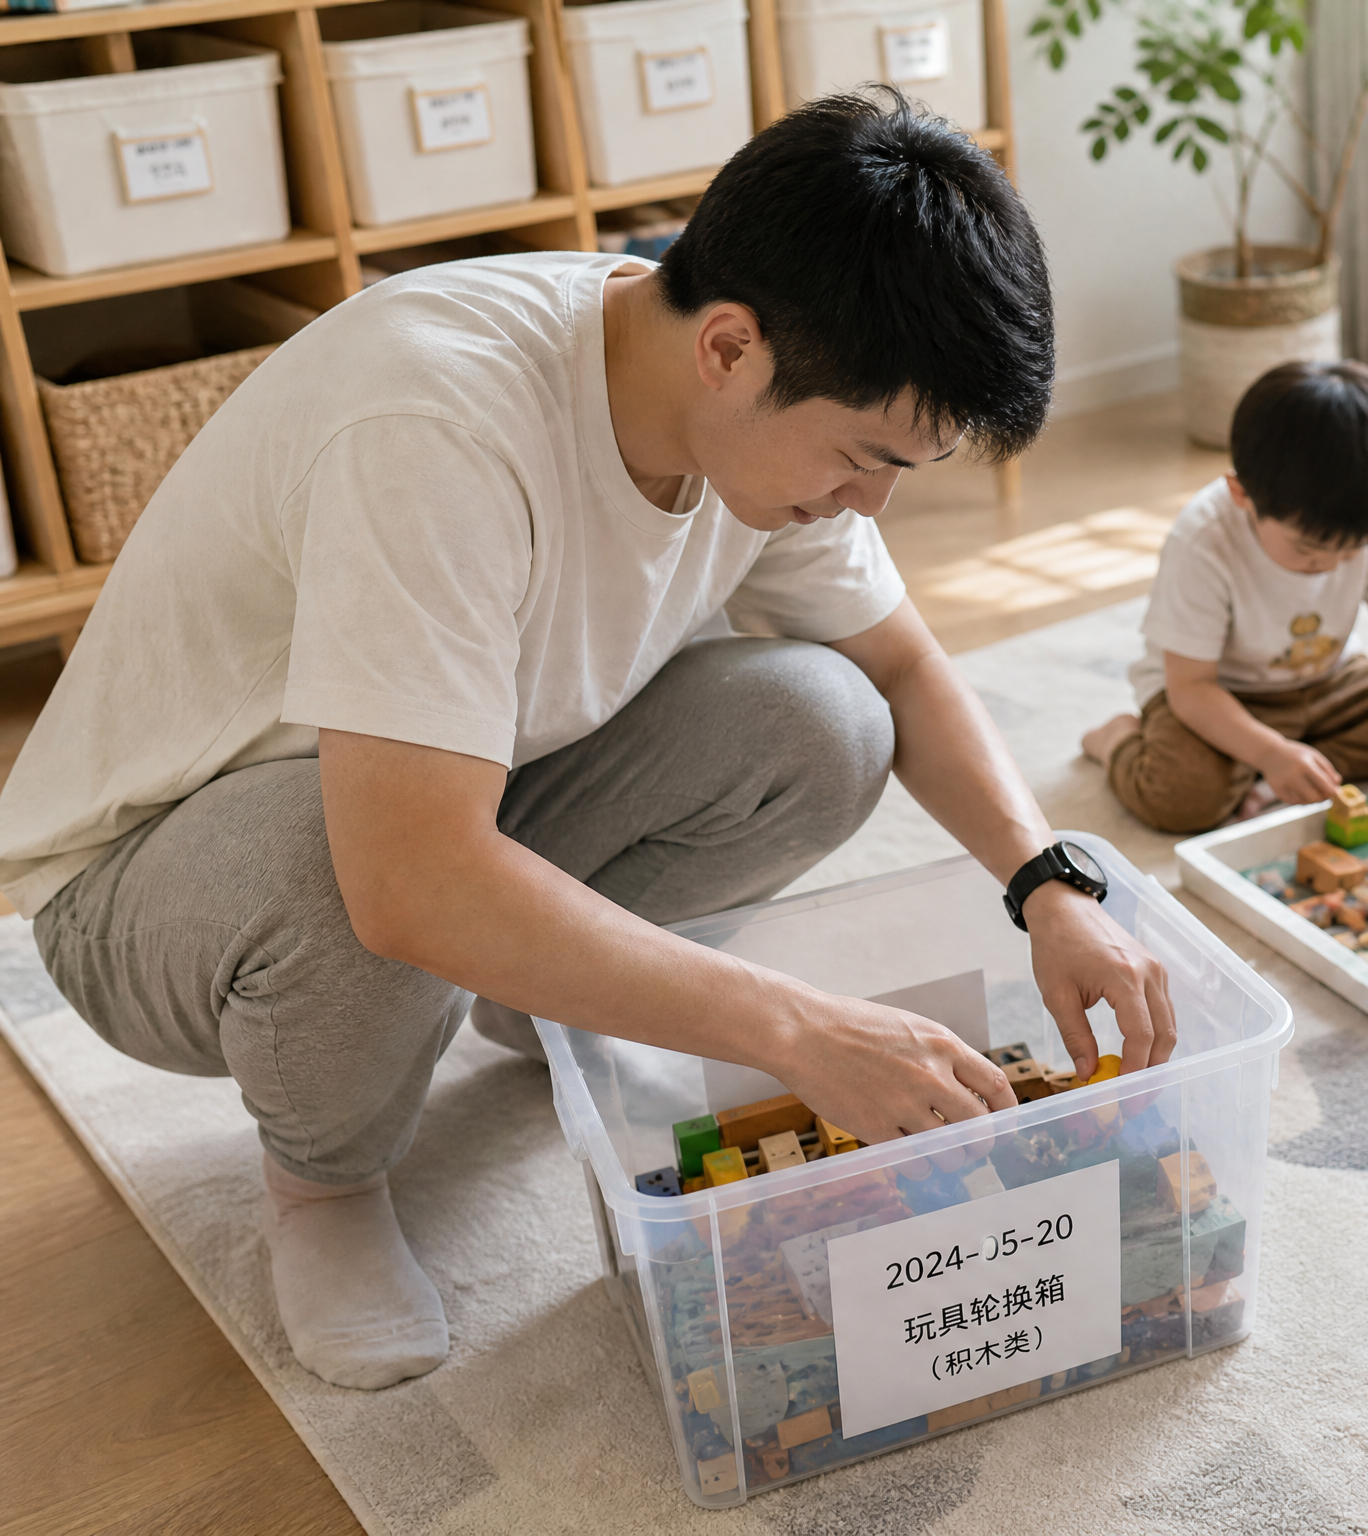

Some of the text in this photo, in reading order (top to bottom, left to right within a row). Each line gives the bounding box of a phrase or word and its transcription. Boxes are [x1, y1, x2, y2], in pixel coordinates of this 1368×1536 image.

[886, 1213, 1074, 1290] 2024-05-20
[903, 1273, 1066, 1345] 玩具轮换箱
[931, 1325, 1043, 1381] （积木类）
